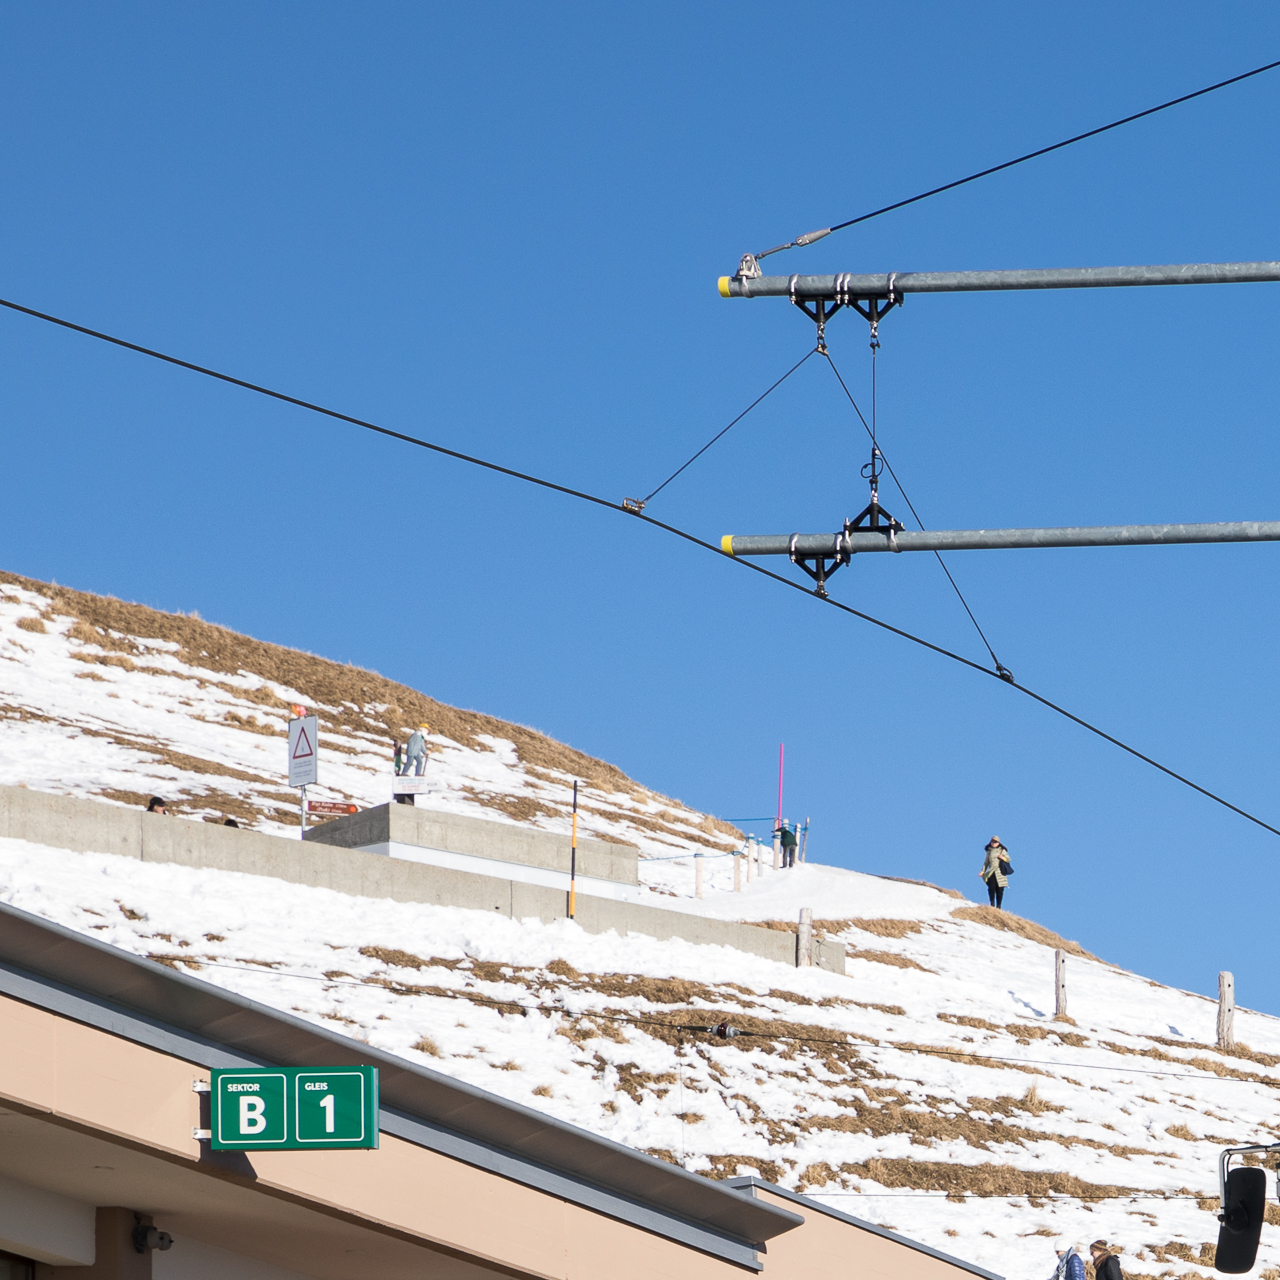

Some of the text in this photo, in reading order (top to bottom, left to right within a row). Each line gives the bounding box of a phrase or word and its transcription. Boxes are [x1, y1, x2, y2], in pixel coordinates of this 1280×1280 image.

[227, 1083, 260, 1092] SEKTOR
[305, 1082, 328, 1091] GLEIS
[239, 1095, 267, 1135] B
[319, 1094, 335, 1133] 1
